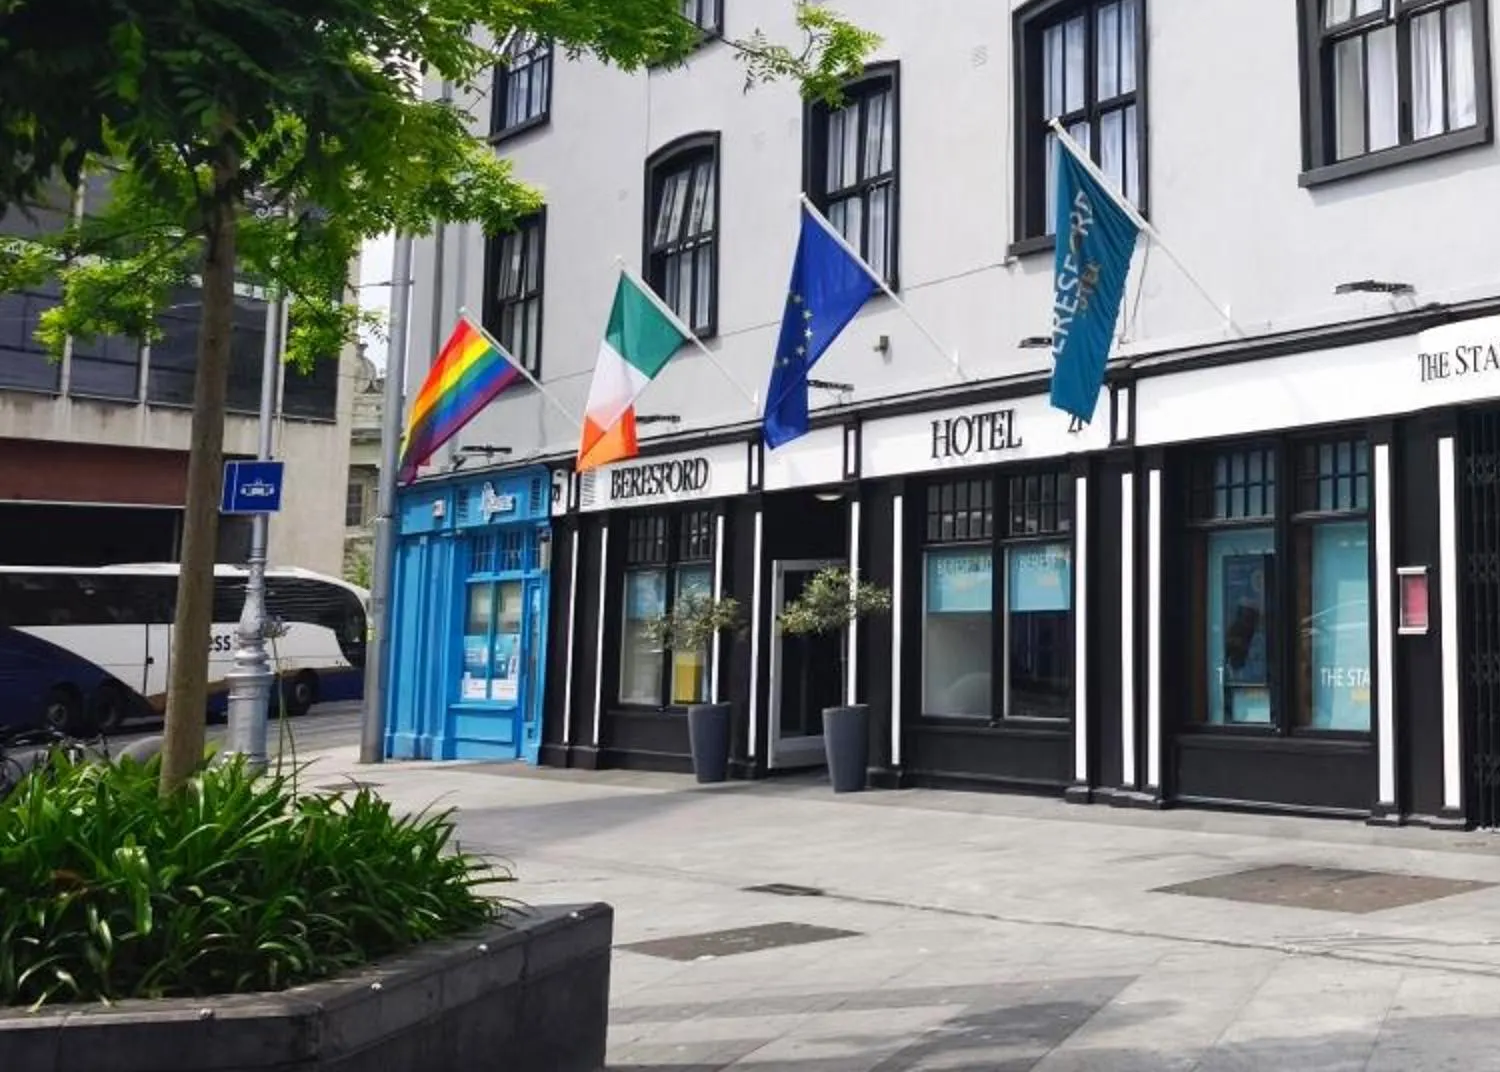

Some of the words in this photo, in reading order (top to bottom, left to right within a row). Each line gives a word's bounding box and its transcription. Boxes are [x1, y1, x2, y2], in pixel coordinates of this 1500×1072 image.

[1418, 352, 1450, 383] THE
[931, 408, 1023, 459] HOTEL
[610, 457, 710, 500] BERESFORD
[1321, 666, 1344, 686] THE
